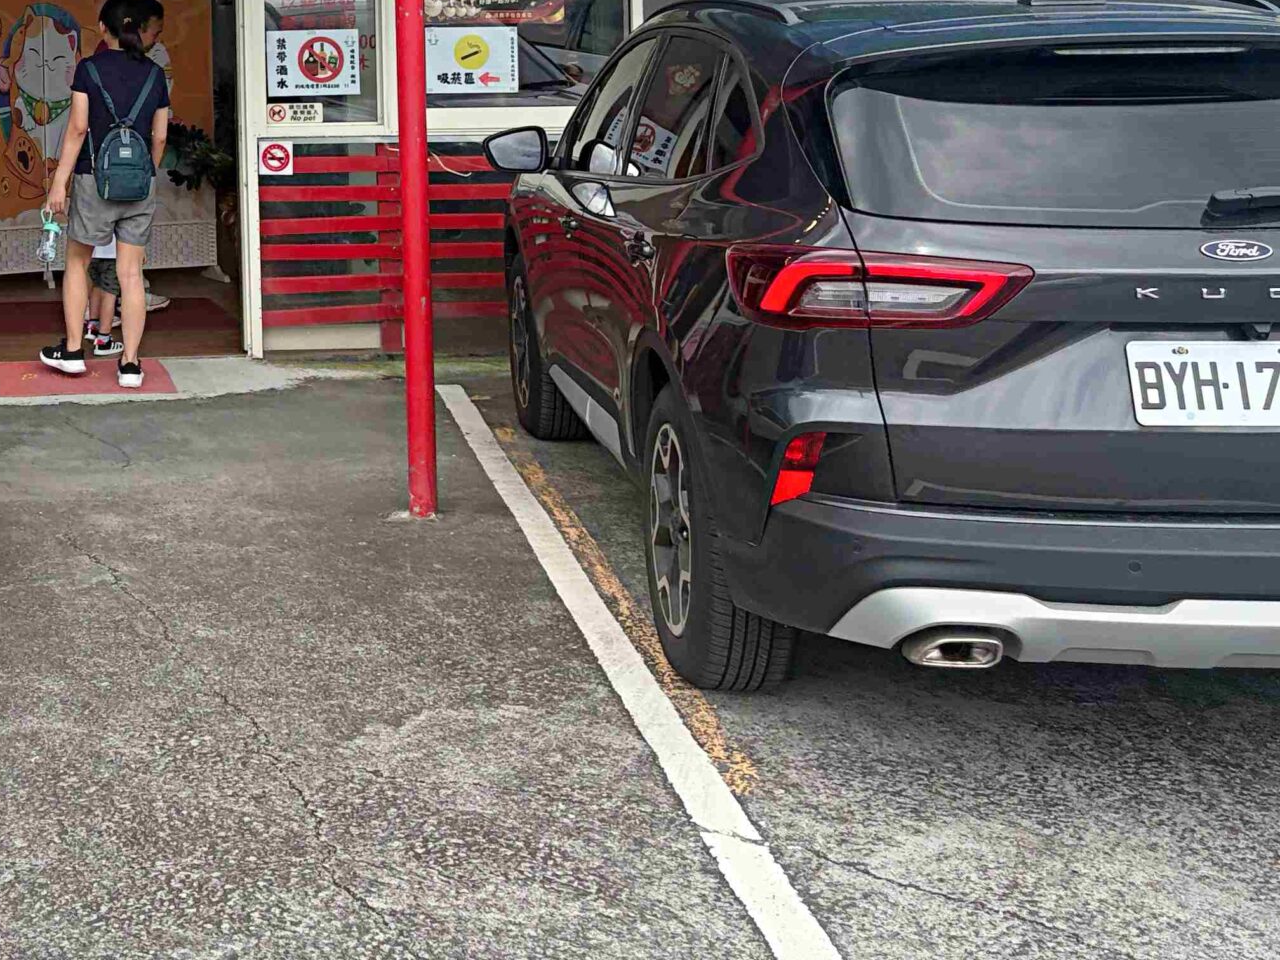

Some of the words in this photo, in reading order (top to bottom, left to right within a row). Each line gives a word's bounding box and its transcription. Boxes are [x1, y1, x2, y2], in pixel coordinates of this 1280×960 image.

[276, 38, 288, 90] 禁帶酒水
[1216, 242, 1260, 258] Ford
